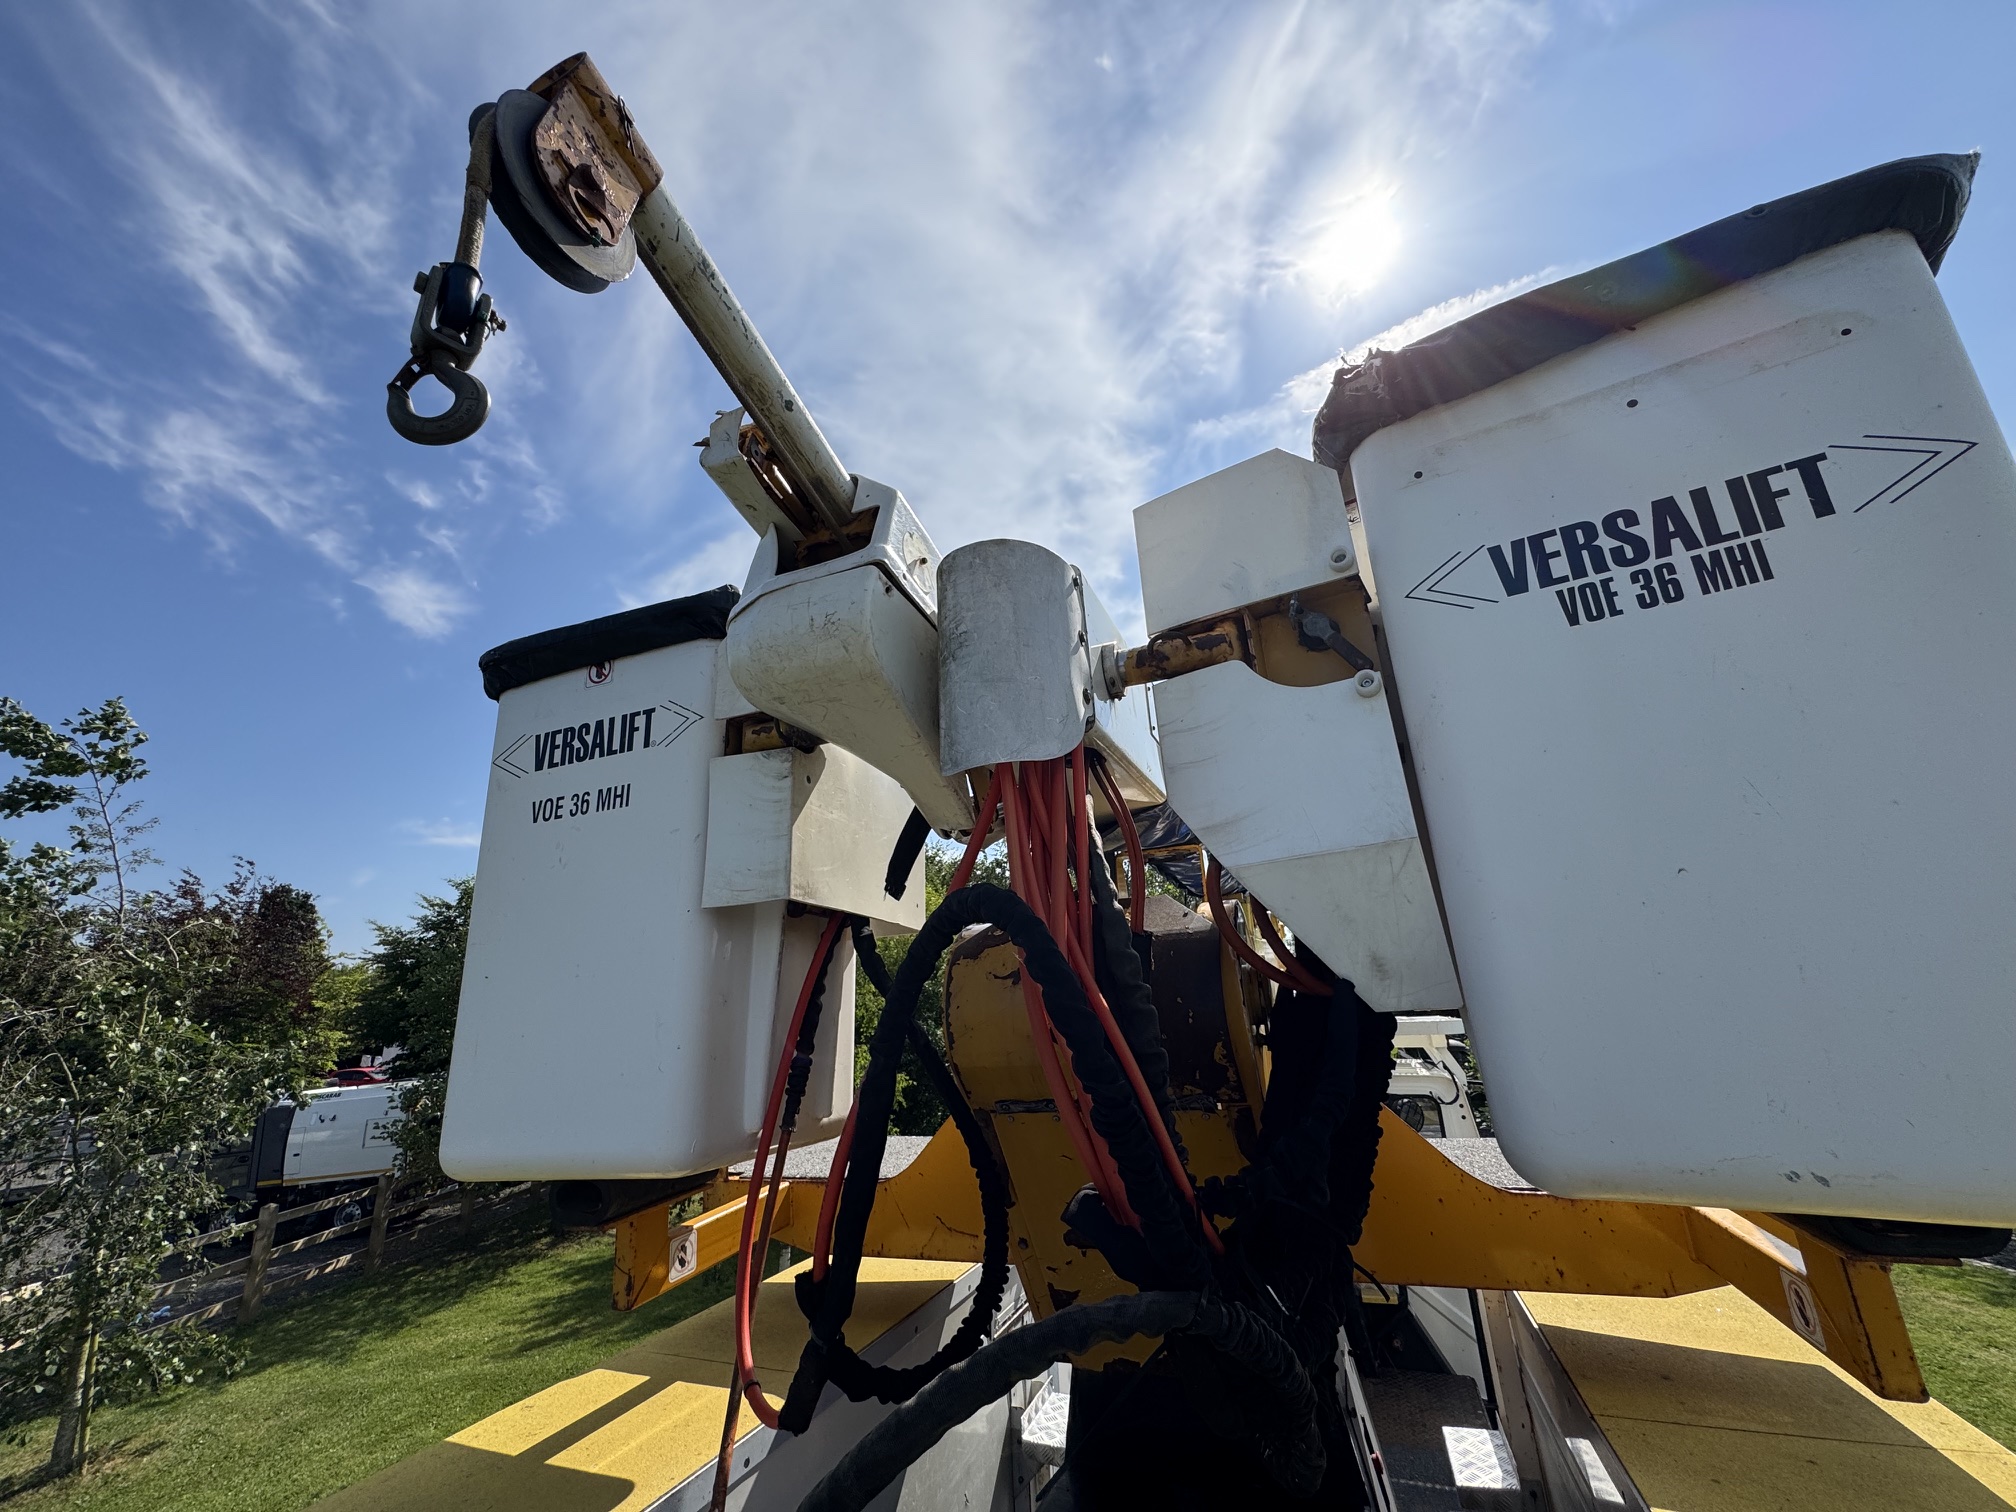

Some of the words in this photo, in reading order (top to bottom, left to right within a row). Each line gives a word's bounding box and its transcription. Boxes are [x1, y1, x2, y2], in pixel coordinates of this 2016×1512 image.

[1486, 452, 1836, 597] VERSALIFT
[1555, 576, 1624, 627] VOE
[1630, 561, 1684, 610] 36
[1691, 538, 1774, 595] MHI
[534, 707, 656, 772] VERSALIFT
[532, 796, 564, 824] VOE
[570, 791, 590, 817] 36
[596, 783, 631, 812] MHI
